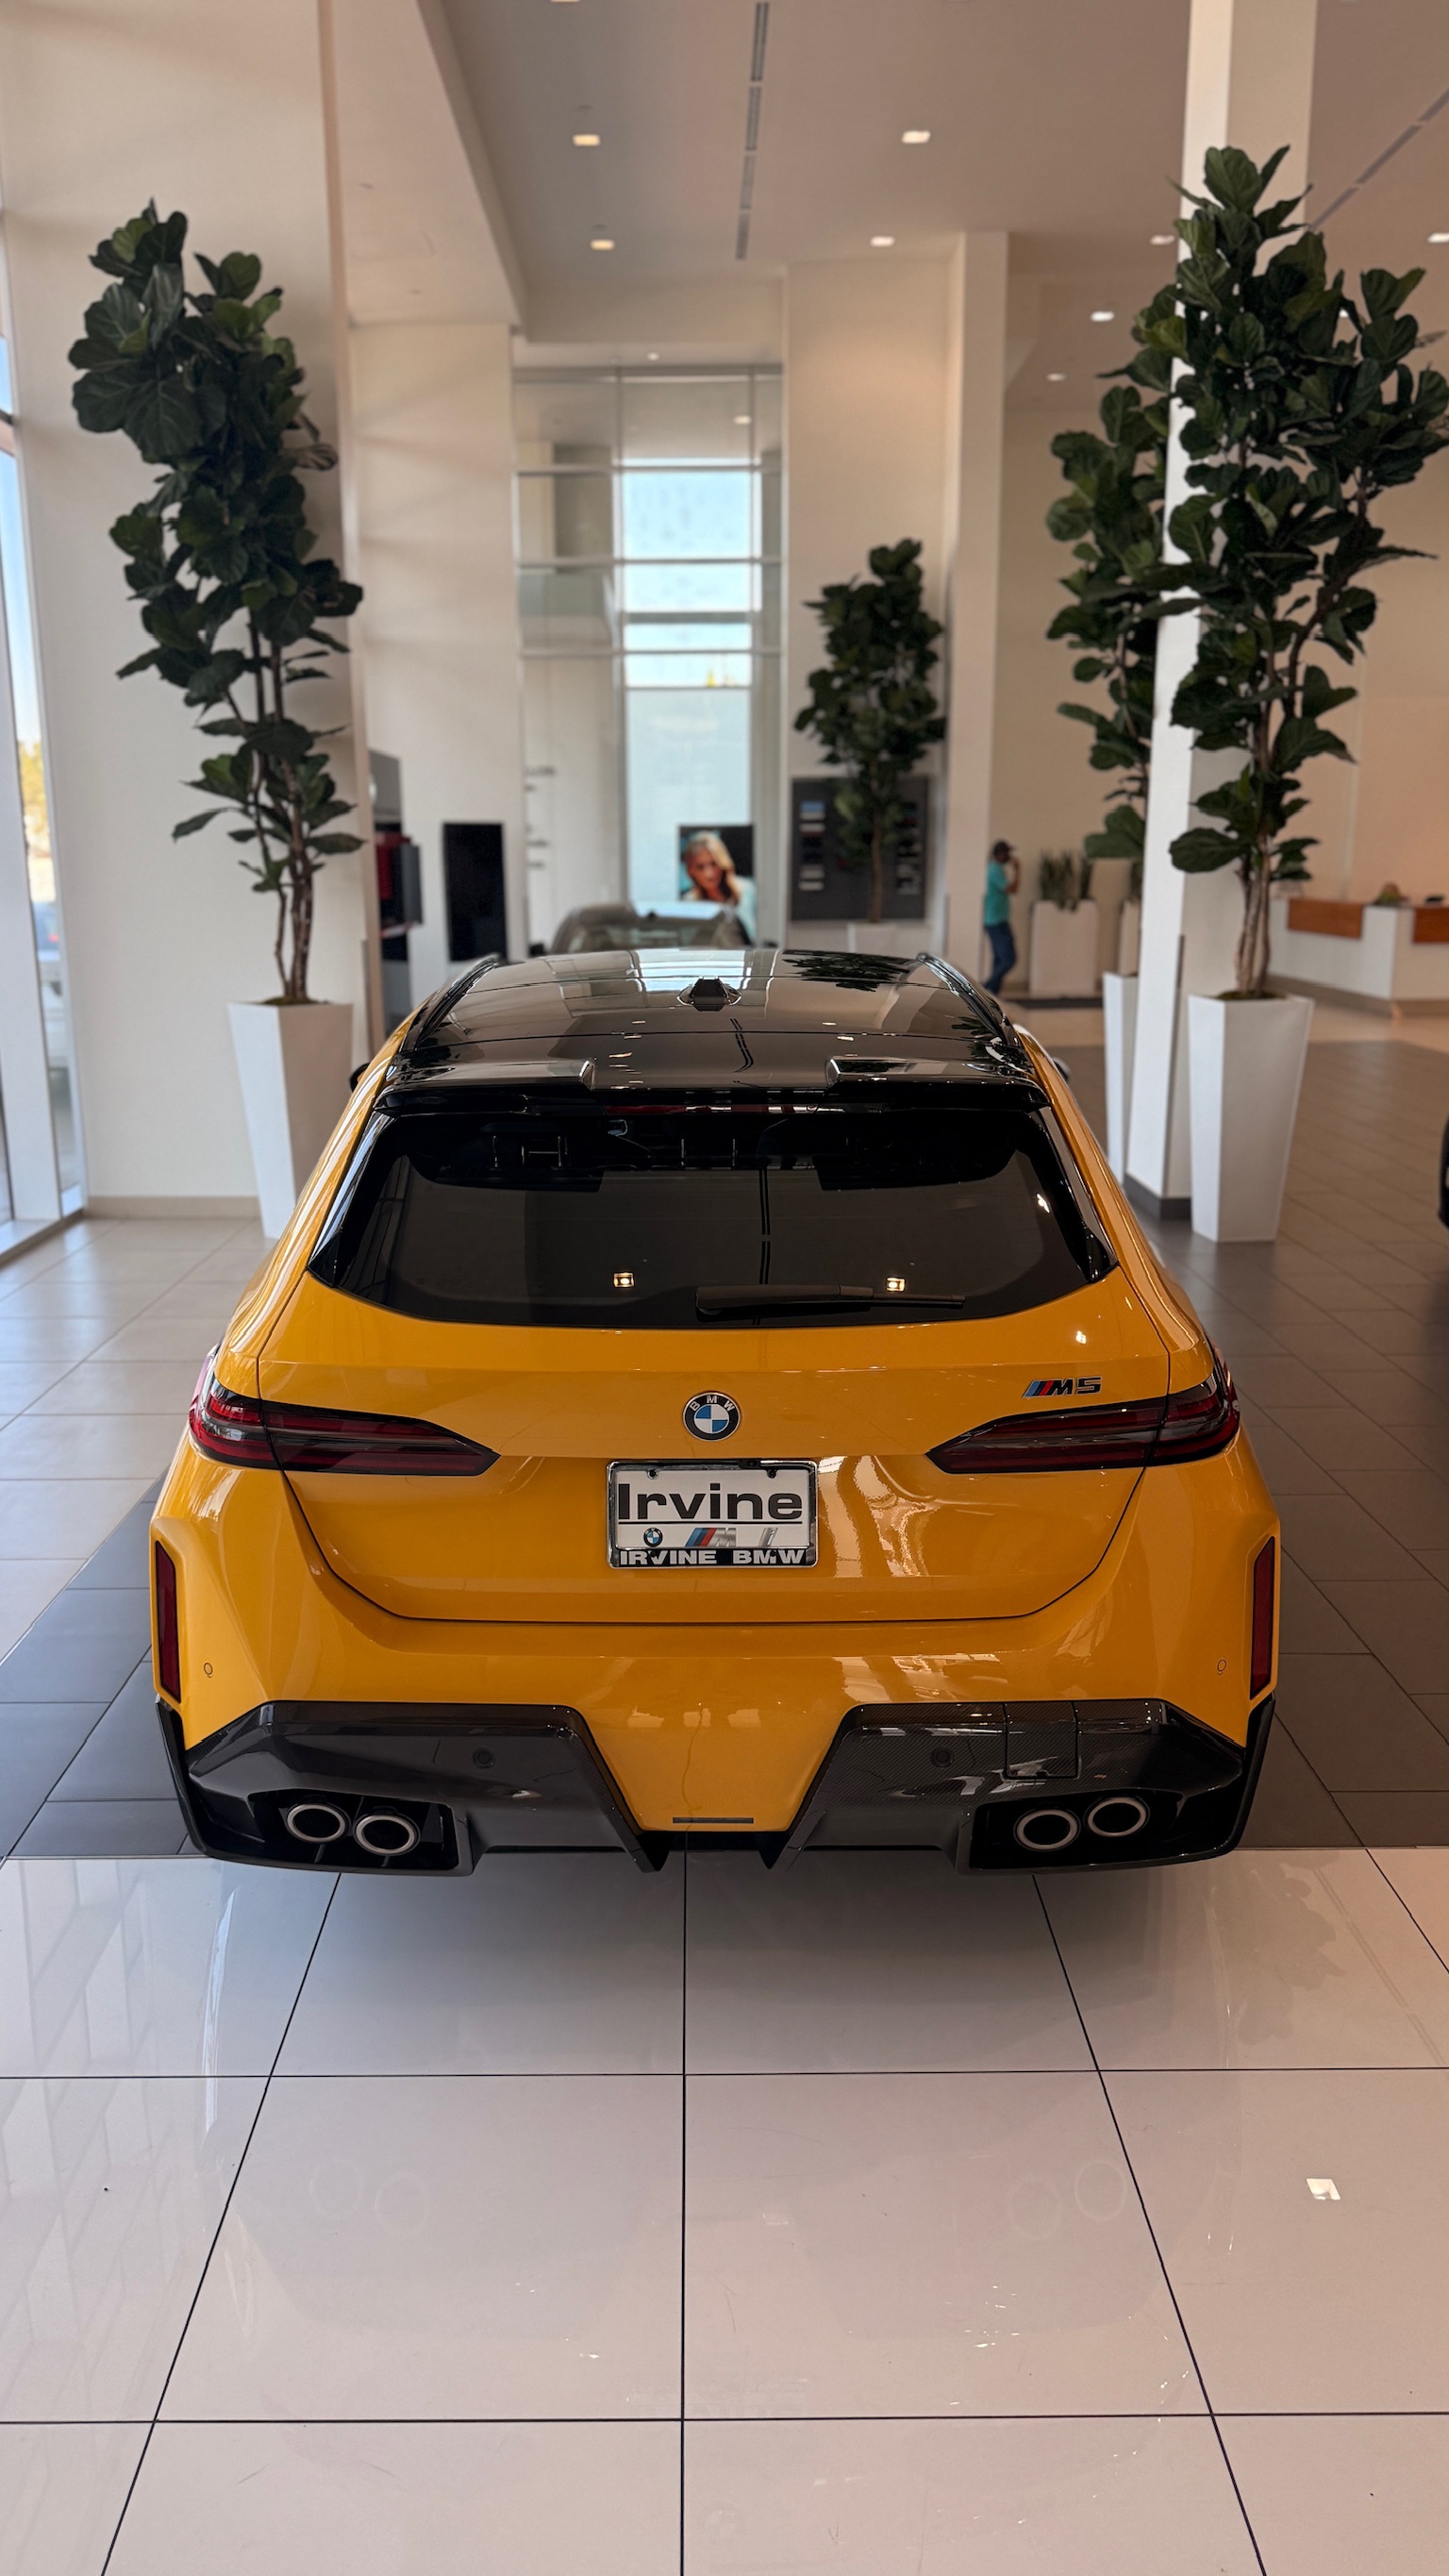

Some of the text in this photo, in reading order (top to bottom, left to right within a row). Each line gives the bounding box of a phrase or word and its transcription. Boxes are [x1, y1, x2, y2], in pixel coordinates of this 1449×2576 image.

[1036, 1377, 1102, 1397] M5
[690, 1395, 735, 1412] BMW
[618, 1483, 803, 1520] Irvine
[620, 1549, 806, 1565] IRVINE BMW
